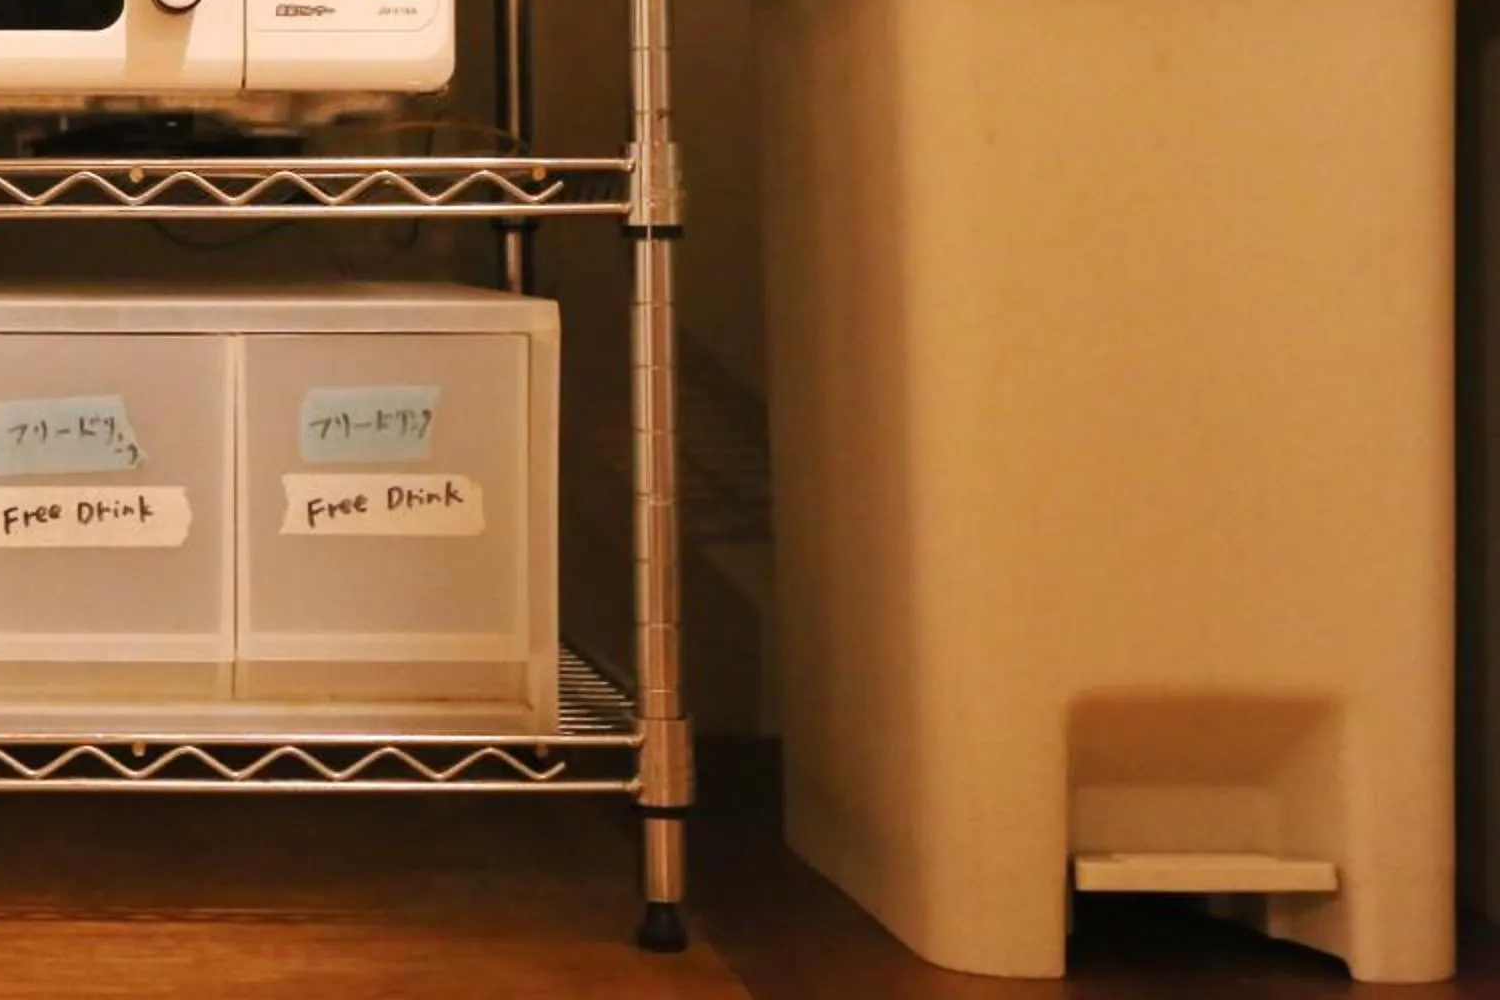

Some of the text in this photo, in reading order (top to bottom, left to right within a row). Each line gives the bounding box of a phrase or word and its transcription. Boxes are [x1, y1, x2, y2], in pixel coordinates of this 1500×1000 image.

[2, 496, 155, 534] Free Drink
[307, 482, 464, 527] Free Drink
